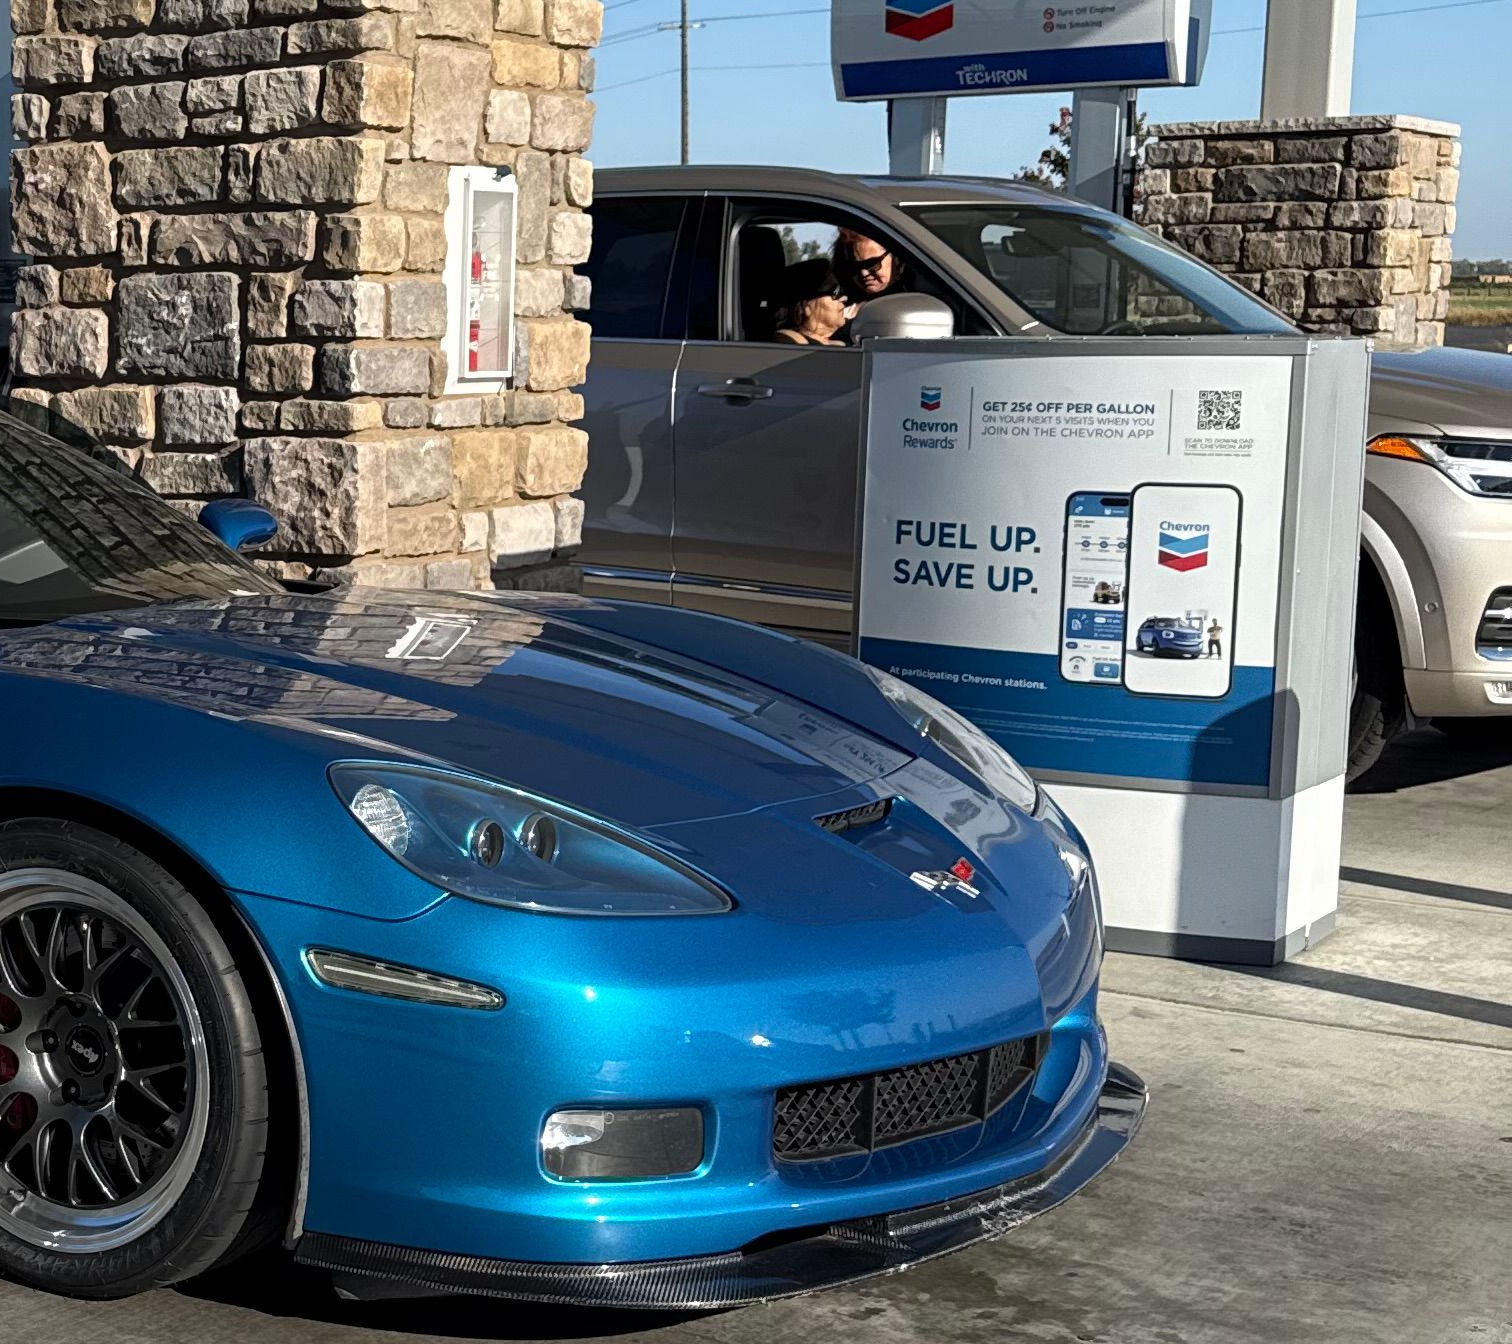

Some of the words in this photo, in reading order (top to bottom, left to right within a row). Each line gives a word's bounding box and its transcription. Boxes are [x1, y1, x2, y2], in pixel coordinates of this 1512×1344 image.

[962, 63, 985, 72] with
[955, 68, 1028, 85] TECHRON
[983, 401, 1007, 412] GET
[1010, 401, 1032, 413] 25¢
[1035, 402, 1063, 413] OFF
[1066, 402, 1093, 414] PER
[1096, 403, 1155, 415] GALLON
[902, 418, 958, 433] Chevron
[982, 415, 996, 423] ON
[999, 415, 1025, 424] YOUR
[1027, 416, 1054, 424] NEXT
[1055, 416, 1061, 424] 5
[1064, 416, 1094, 425] VISITS
[1097, 417, 1130, 426] WHEN
[1133, 417, 1155, 426] YOU
[981, 426, 1008, 436] JOIN
[1011, 426, 1030, 436] ON
[1033, 427, 1057, 437] THE
[1060, 428, 1124, 439] CHEVRON
[1127, 429, 1154, 439] APP
[903, 435, 955, 449] Rewards
[1159, 521, 1210, 533] Chevron
[895, 519, 977, 550] FUEL
[990, 525, 1041, 554] UP.
[892, 558, 974, 589] SAVE
[987, 565, 1038, 594] UP.
[889, 665, 900, 674] At
[901, 668, 959, 683] participating
[961, 673, 1002, 685] Chevron
[1004, 678, 1048, 690] stations.
